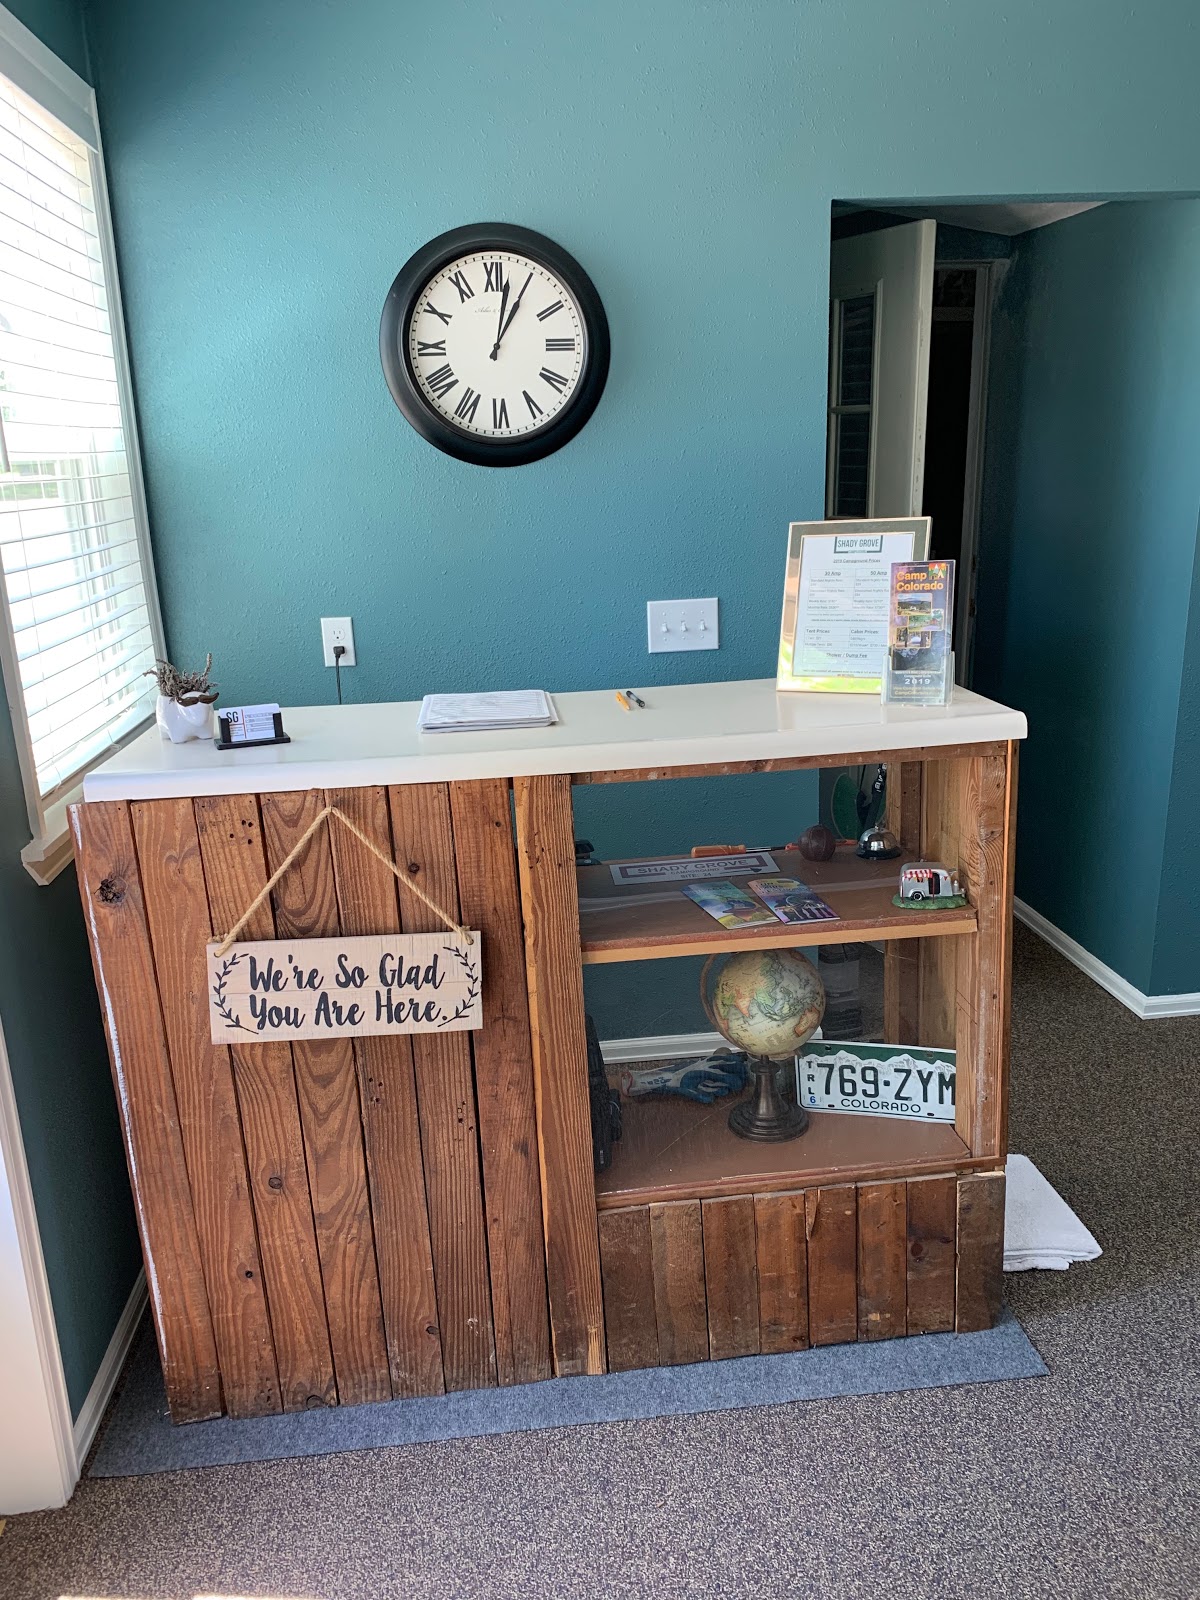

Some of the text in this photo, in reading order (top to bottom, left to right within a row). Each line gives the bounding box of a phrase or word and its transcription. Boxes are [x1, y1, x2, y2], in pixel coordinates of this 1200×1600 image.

[448, 270, 475, 304] XI
[483, 262, 503, 293] XII
[423, 301, 453, 326] X
[536, 300, 564, 322] II
[417, 340, 446, 356] IX
[545, 338, 575, 352] III
[425, 363, 459, 400] VIII
[454, 387, 481, 423] VII
[493, 398, 510, 429] VI
[522, 390, 543, 419] V
[837, 538, 879, 548] SHADY GROVE
[896, 571, 927, 581] Camp
[896, 581, 944, 591] Colorado
[226, 711, 239, 724] SG
[637, 859, 749, 874] SHADY GROVE
[249, 952, 446, 992] We're So Glad
[249, 988, 448, 1031] You Are Here.
[809, 1095, 816, 1104] 6
[841, 1098, 921, 1114] COLORADO
